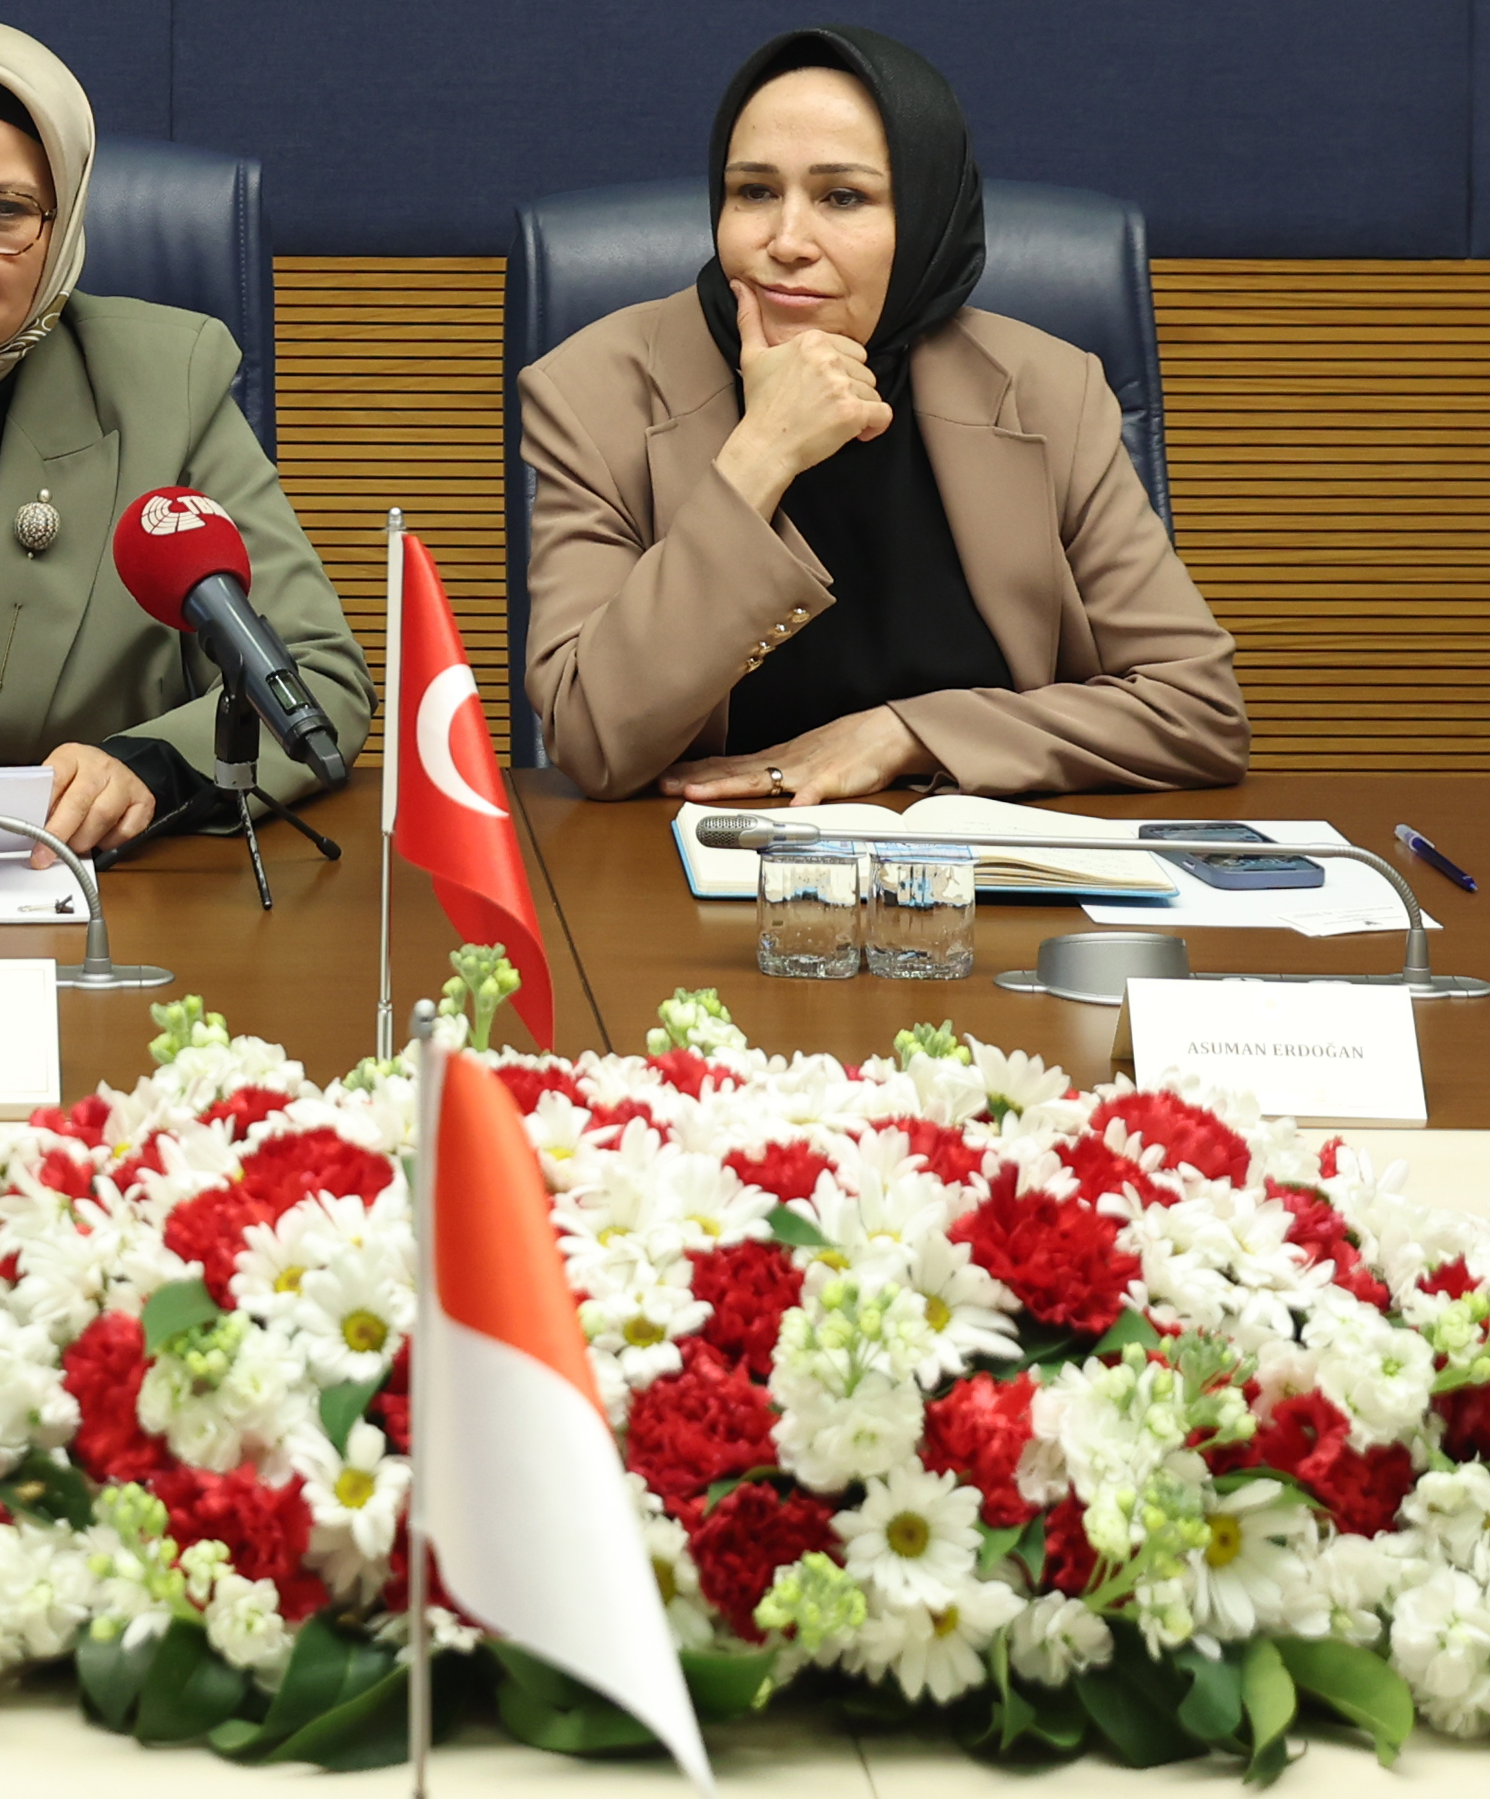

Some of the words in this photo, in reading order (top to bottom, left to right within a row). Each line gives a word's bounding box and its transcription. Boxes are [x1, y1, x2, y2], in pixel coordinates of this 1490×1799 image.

[177, 495, 237, 528] TB
[1187, 1041, 1267, 1056] ASUMAN
[1272, 1042, 1365, 1060] ERDOĞAN
